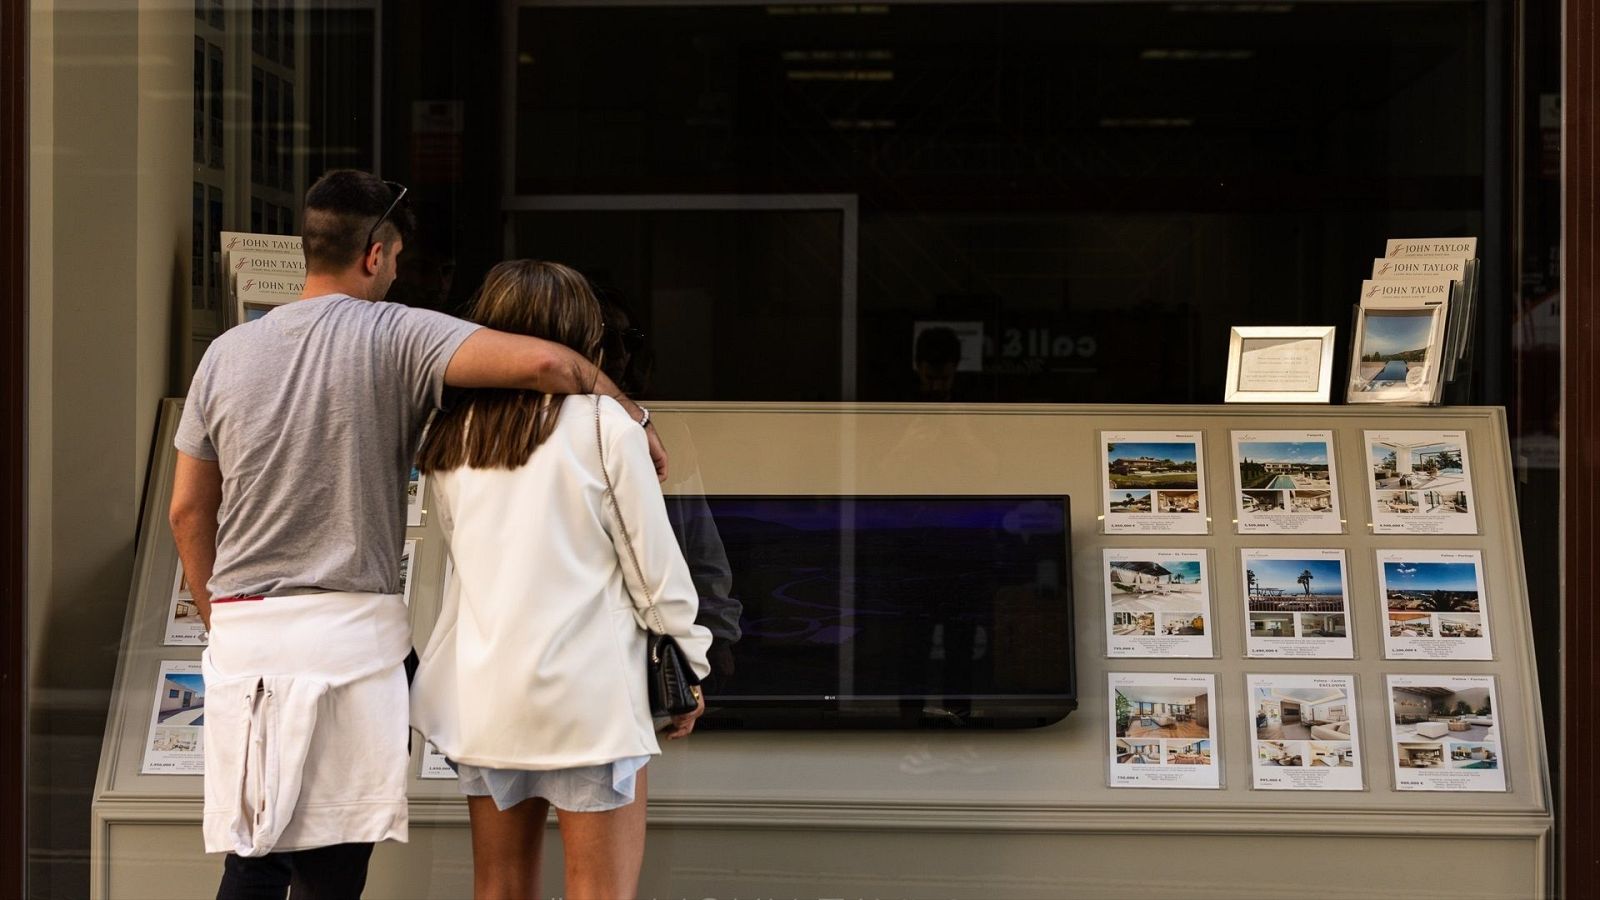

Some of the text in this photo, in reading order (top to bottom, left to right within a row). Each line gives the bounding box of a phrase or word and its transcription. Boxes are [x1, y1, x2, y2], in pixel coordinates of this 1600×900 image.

[242, 238, 303, 250] JOHN TAYLO
[1405, 244, 1470, 253] JOHN TAYLOR
[251, 259, 307, 270] JOHN TAYL
[1393, 263, 1459, 272] JOHN TAYLOR
[258, 281, 284, 290] JOHN
[1382, 285, 1444, 295] JOHN TAYLOR
